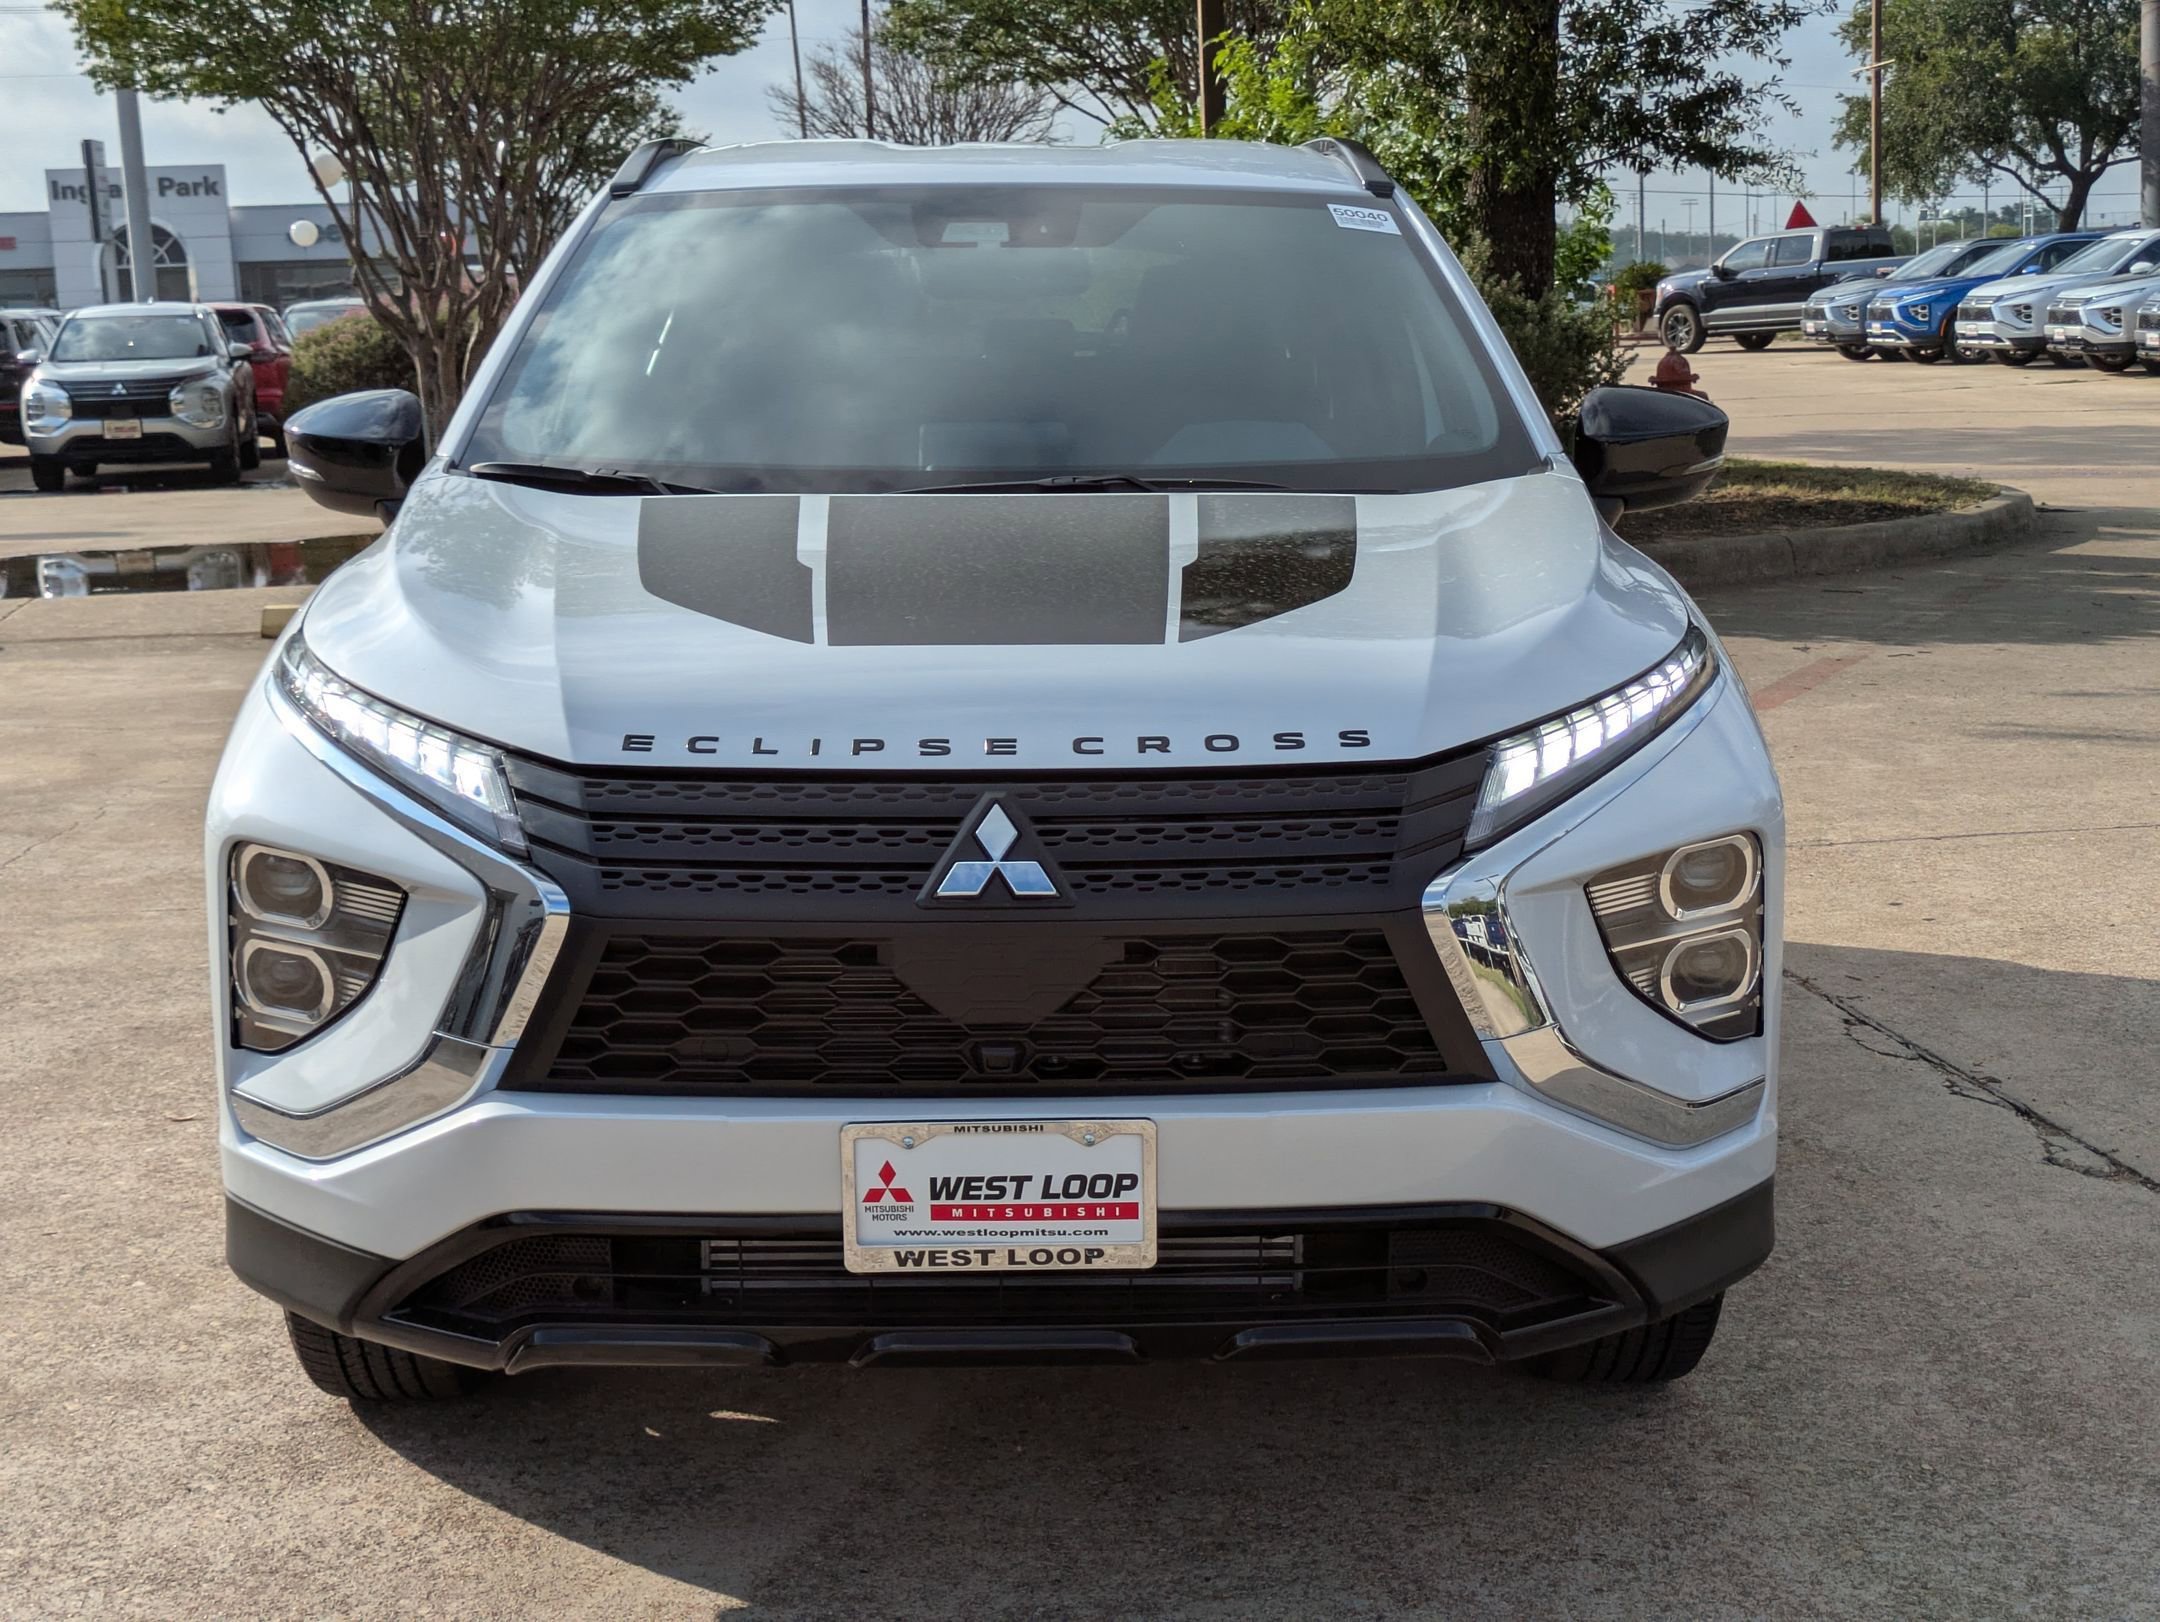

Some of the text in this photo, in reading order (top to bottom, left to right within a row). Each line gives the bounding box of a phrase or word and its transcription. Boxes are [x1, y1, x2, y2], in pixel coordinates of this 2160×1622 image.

[157, 176, 220, 197] Park
[1333, 208, 1388, 222] 50040
[621, 729, 1371, 756] ECLIPSE CROSS
[953, 1124, 1044, 1133] MITSUBISHI
[930, 1173, 1139, 1200] WEST LOOP
[864, 1205, 915, 1214] MITSUBISHI
[951, 1206, 1121, 1218] MITSUBISHI
[872, 1213, 908, 1221] MOTORS
[893, 1228, 1109, 1238] www.westloopmitsu.com
[894, 1248, 1105, 1268] WEST LOOP
